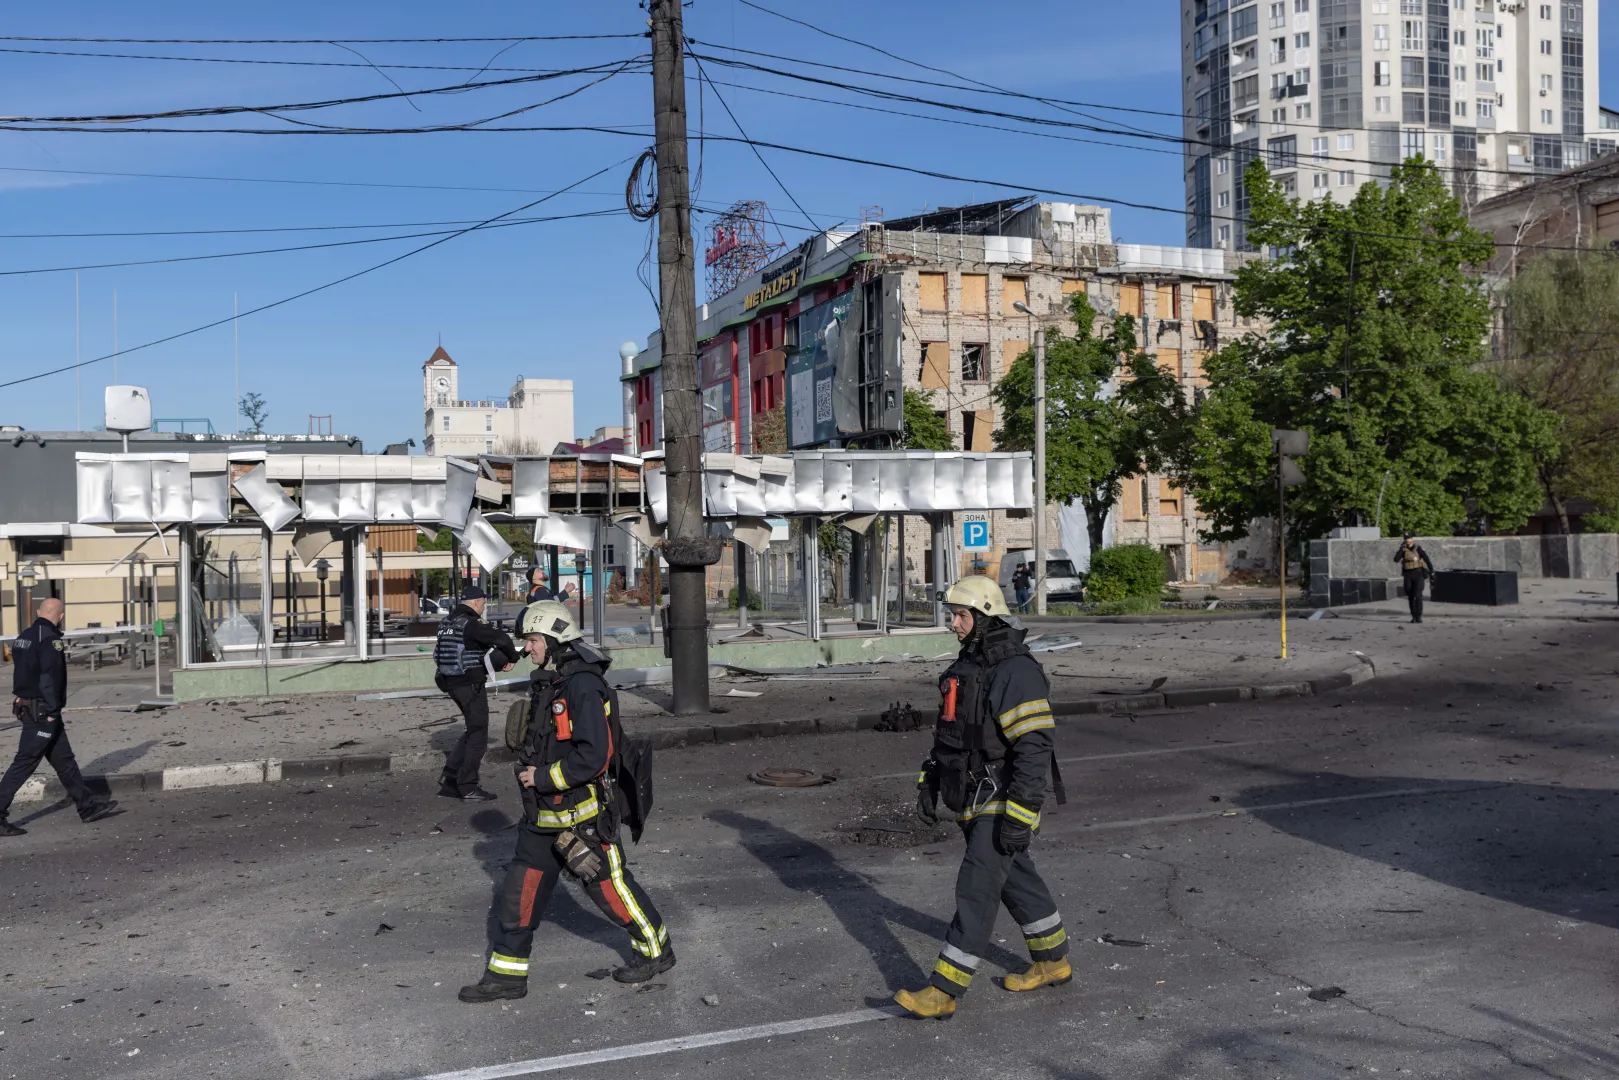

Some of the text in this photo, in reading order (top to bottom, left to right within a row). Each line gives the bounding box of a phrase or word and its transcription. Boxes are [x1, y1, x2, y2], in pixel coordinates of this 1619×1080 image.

[743, 267, 799, 311] METALIST
[964, 514, 986, 522] ЗОНА
[969, 524, 984, 545] P
